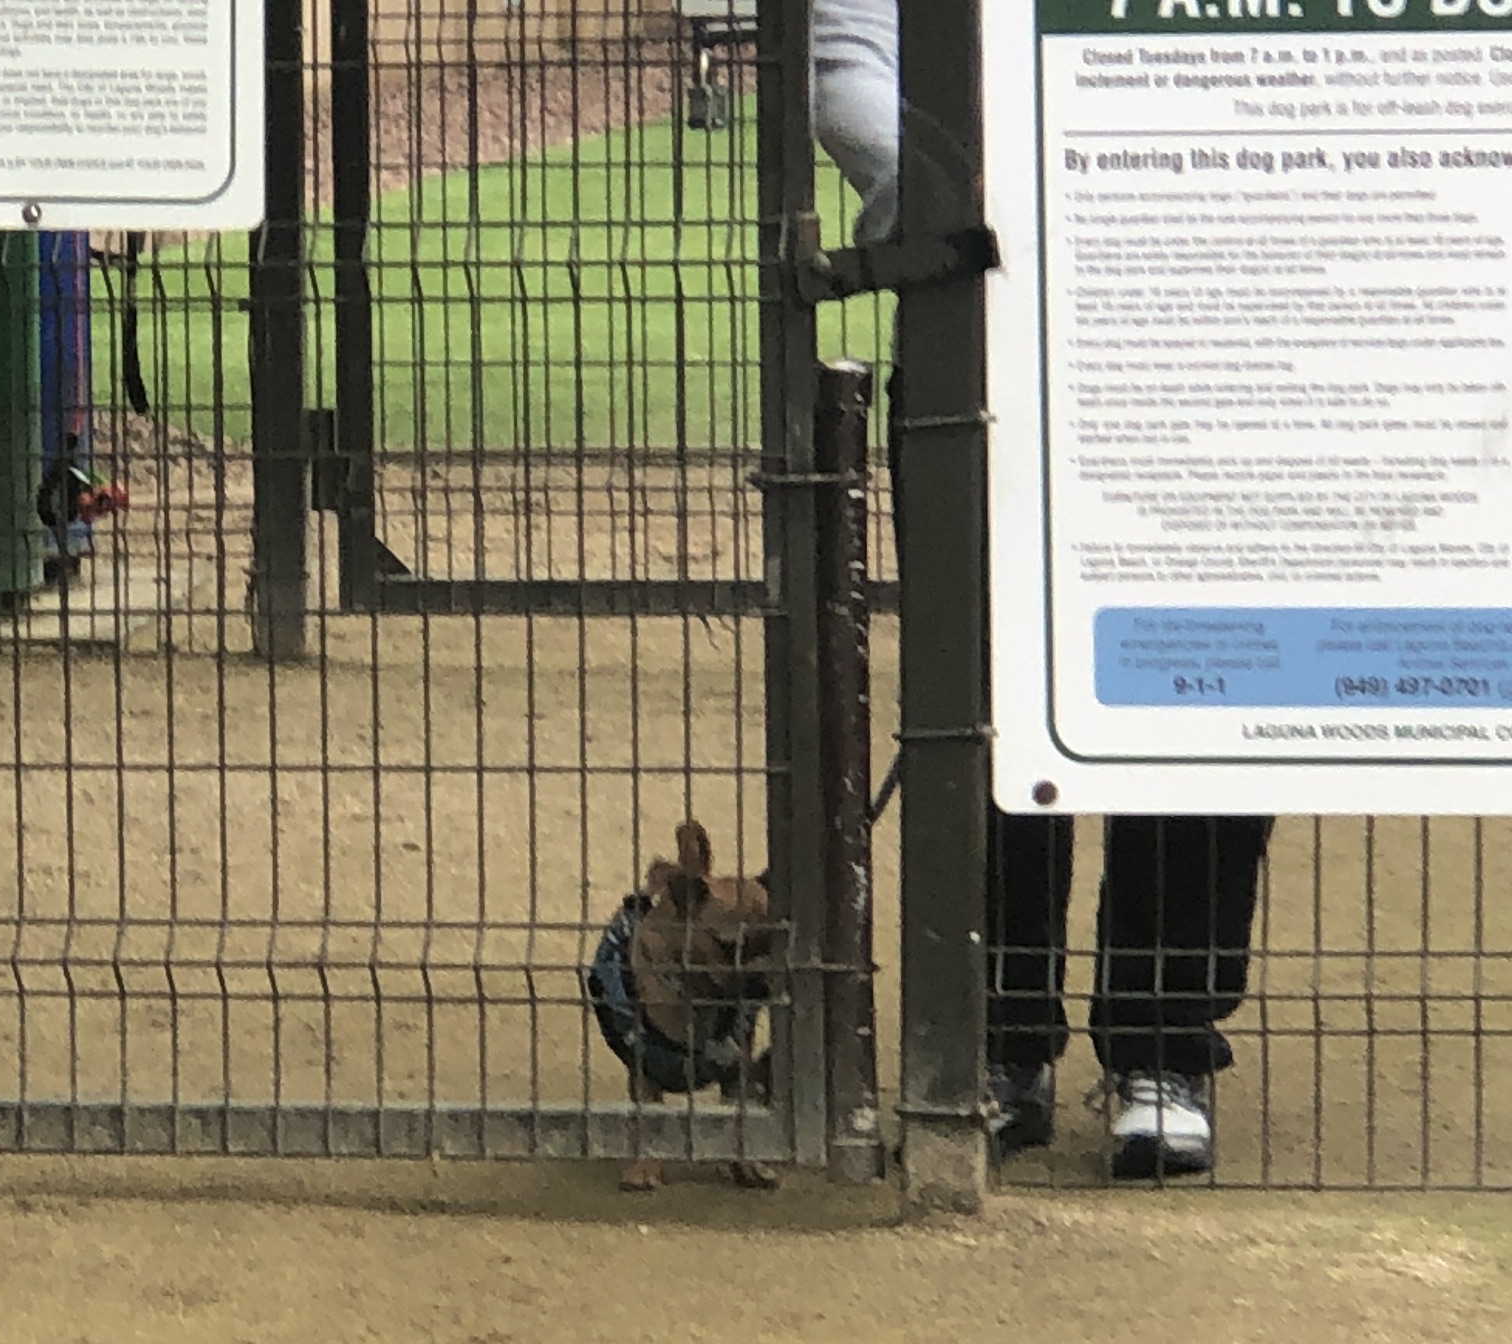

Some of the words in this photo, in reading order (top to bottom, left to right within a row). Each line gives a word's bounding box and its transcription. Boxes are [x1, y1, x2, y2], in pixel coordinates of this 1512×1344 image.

[1064, 147, 1091, 175] By
[1097, 147, 1183, 174] entering
[1190, 147, 1230, 170] this
[1236, 145, 1275, 174] dog
[1281, 146, 1336, 173] park,
[1342, 149, 1381, 173] you
[1387, 145, 1433, 169] also
[1173, 674, 1226, 696] 9-1-1
